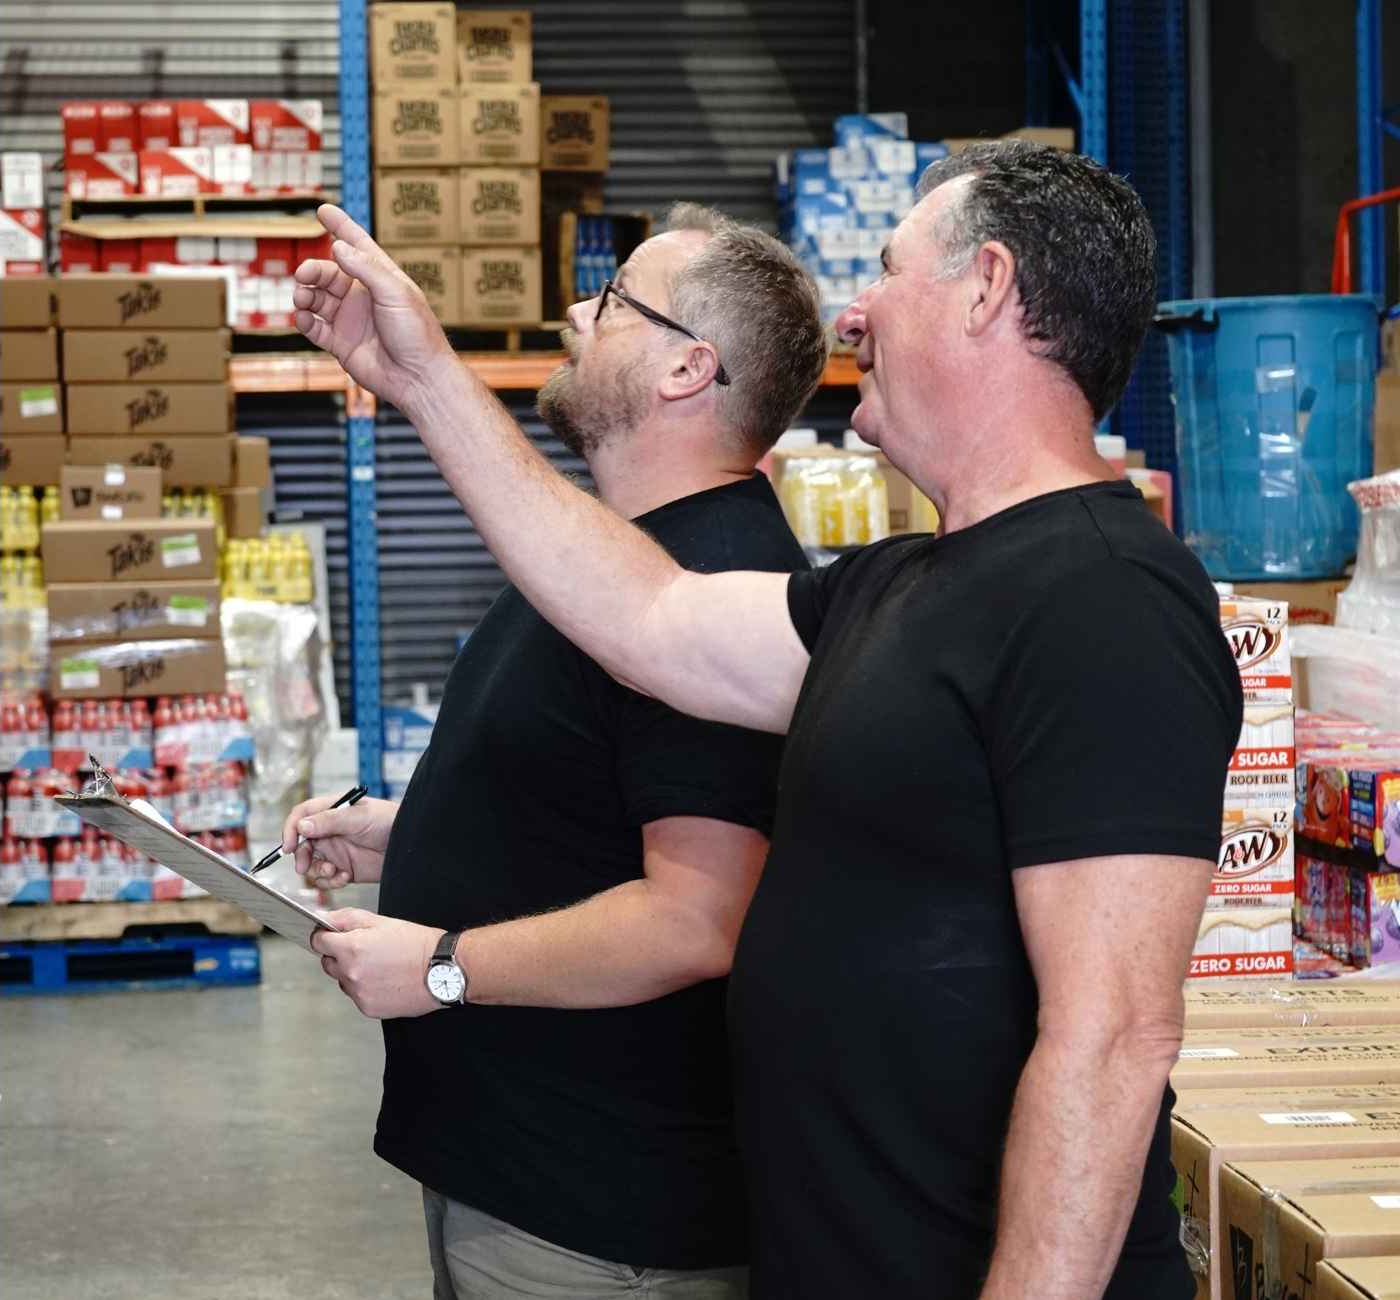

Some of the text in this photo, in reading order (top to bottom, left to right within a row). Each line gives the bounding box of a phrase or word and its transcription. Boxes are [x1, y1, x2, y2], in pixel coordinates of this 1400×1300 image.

[1267, 607, 1281, 619] 12
[1241, 678, 1267, 687] UGAR
[1238, 751, 1288, 767] SUGAR
[1231, 773, 1288, 785] ROOT BEER
[1273, 810, 1287, 823] 12
[1218, 831, 1267, 872] A&W
[1215, 883, 1272, 894] ZERO SUGAR
[1190, 956, 1285, 974] ZERO SUGAR
